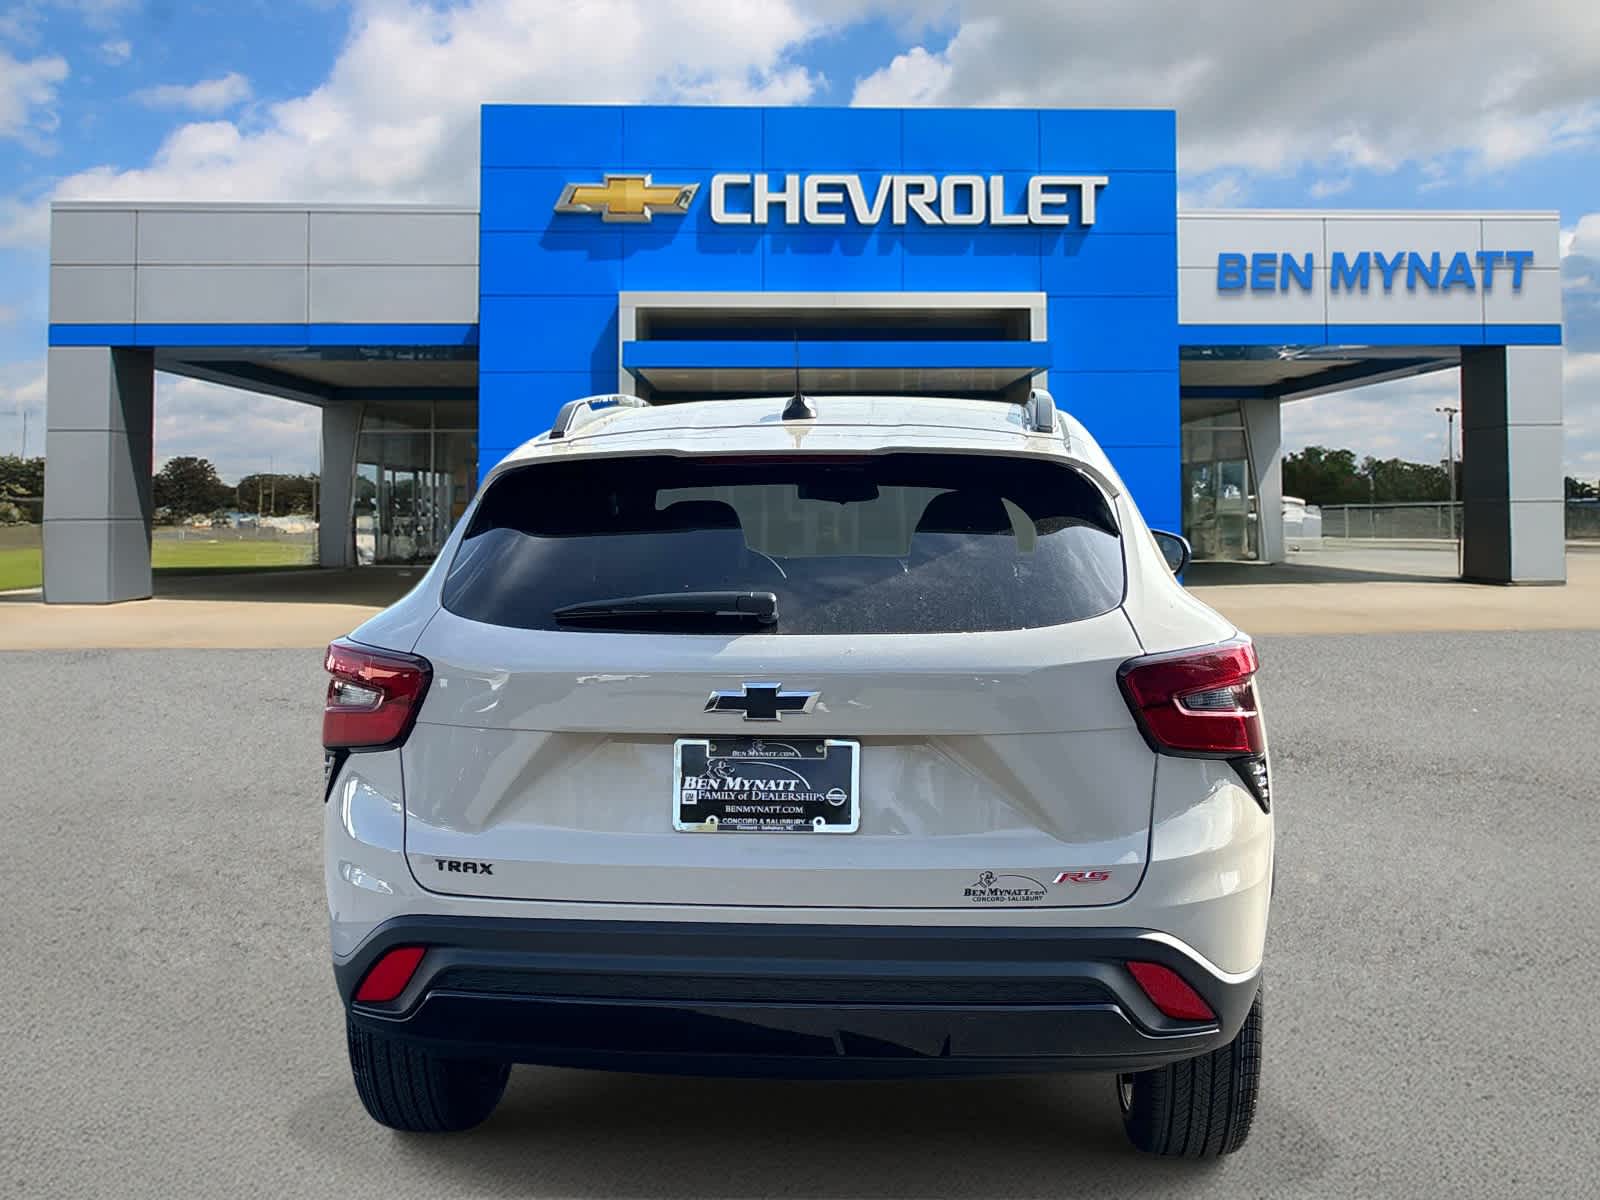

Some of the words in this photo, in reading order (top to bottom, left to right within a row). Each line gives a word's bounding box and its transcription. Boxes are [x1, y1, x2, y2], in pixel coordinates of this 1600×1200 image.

[710, 173, 1109, 226] CHEVROLET
[1217, 253, 1313, 290] BEN
[1330, 251, 1534, 290] MYNATT
[683, 777, 721, 790] BEN
[724, 777, 799, 791] MYNATT
[699, 790, 735, 800] FAMILY
[737, 792, 747, 801] of
[751, 791, 825, 802] DEALERSHIPS
[725, 805, 803, 814] BENMYNATT.COM
[434, 859, 494, 875] TRAX
[1053, 870, 1112, 883] RS
[964, 888, 986, 896] BEN
